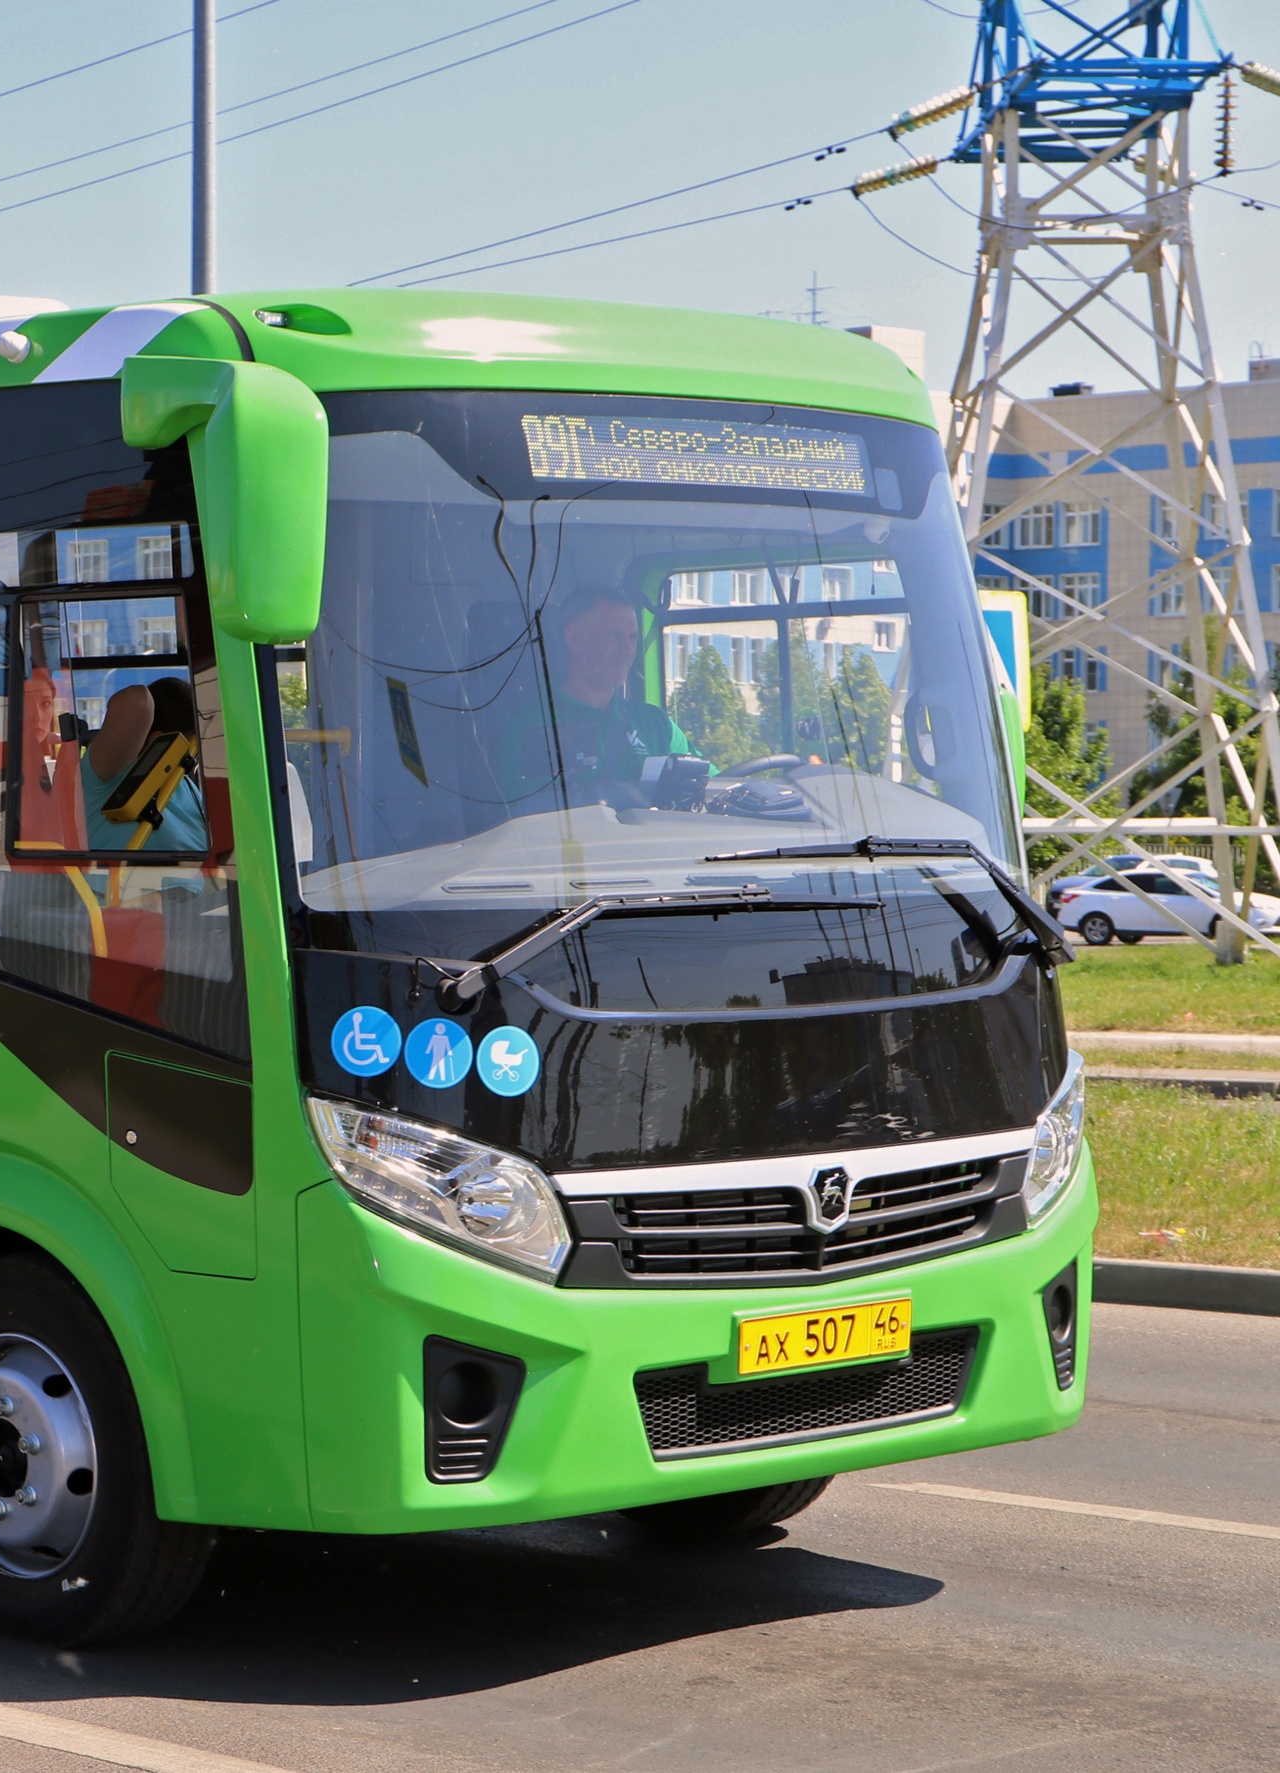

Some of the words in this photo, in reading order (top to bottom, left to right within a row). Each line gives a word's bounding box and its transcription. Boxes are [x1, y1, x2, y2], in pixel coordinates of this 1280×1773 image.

[610, 420, 847, 461] Северо-Западный
[804, 1313, 856, 1357] 507
[874, 1305, 900, 1336] 46
[876, 1337, 897, 1350] RUS
